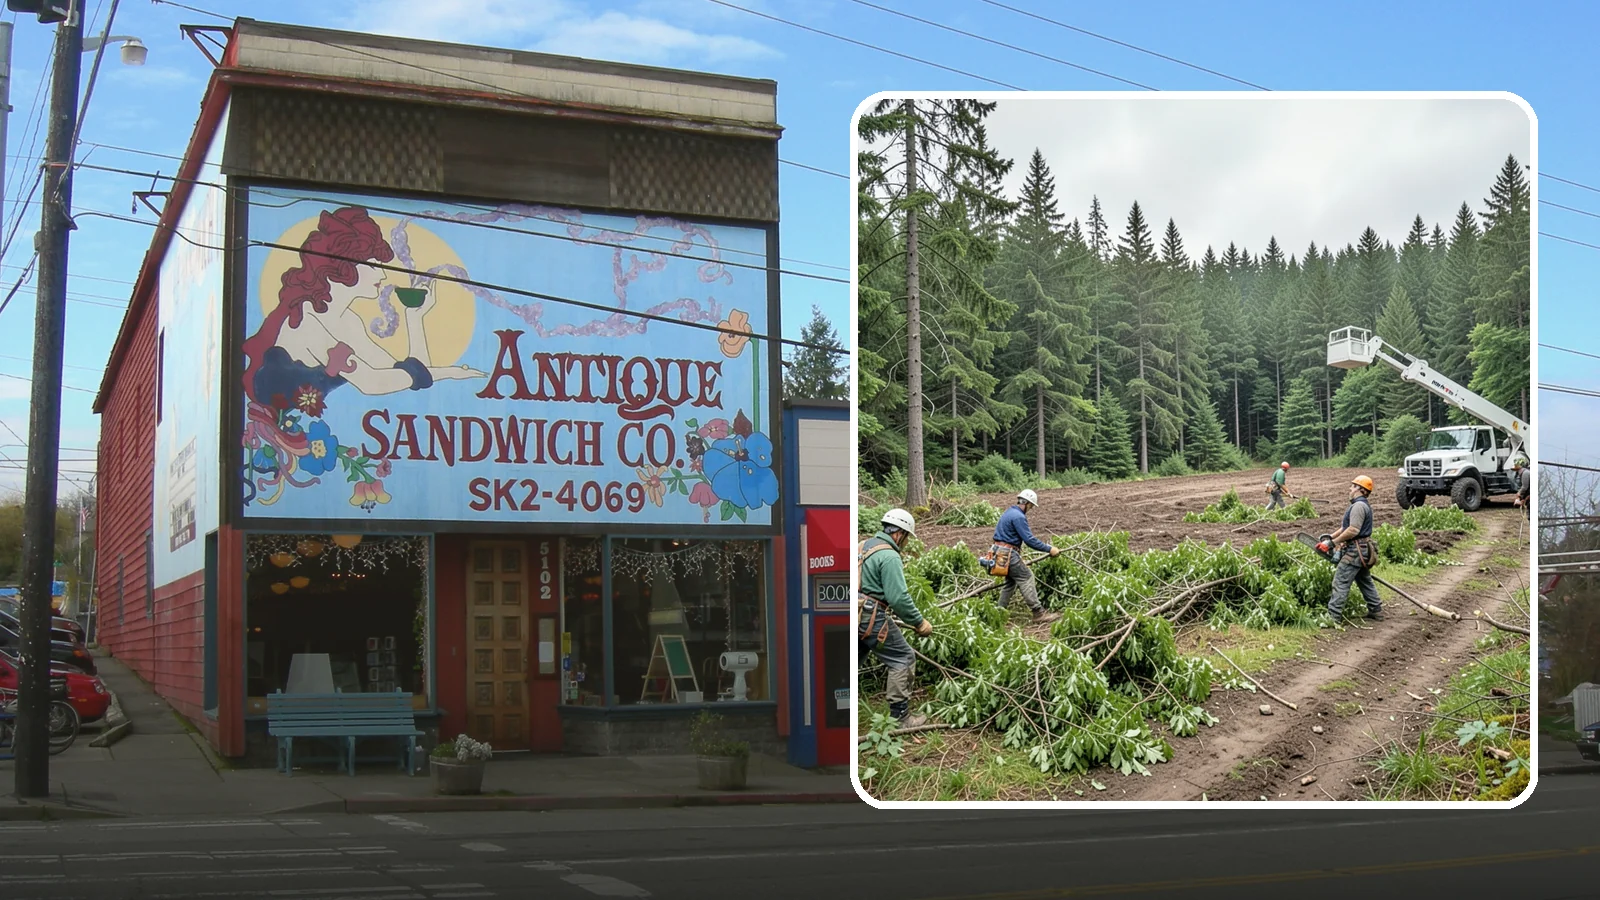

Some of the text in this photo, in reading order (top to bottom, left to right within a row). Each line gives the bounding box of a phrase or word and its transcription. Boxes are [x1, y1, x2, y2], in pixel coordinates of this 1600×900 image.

[477, 330, 723, 420] ANTIQUE
[362, 409, 684, 468] SANDWICH CO.
[468, 477, 645, 512] SK2-4069
[540, 541, 551, 599] 5102
[809, 555, 834, 568] BOOKS
